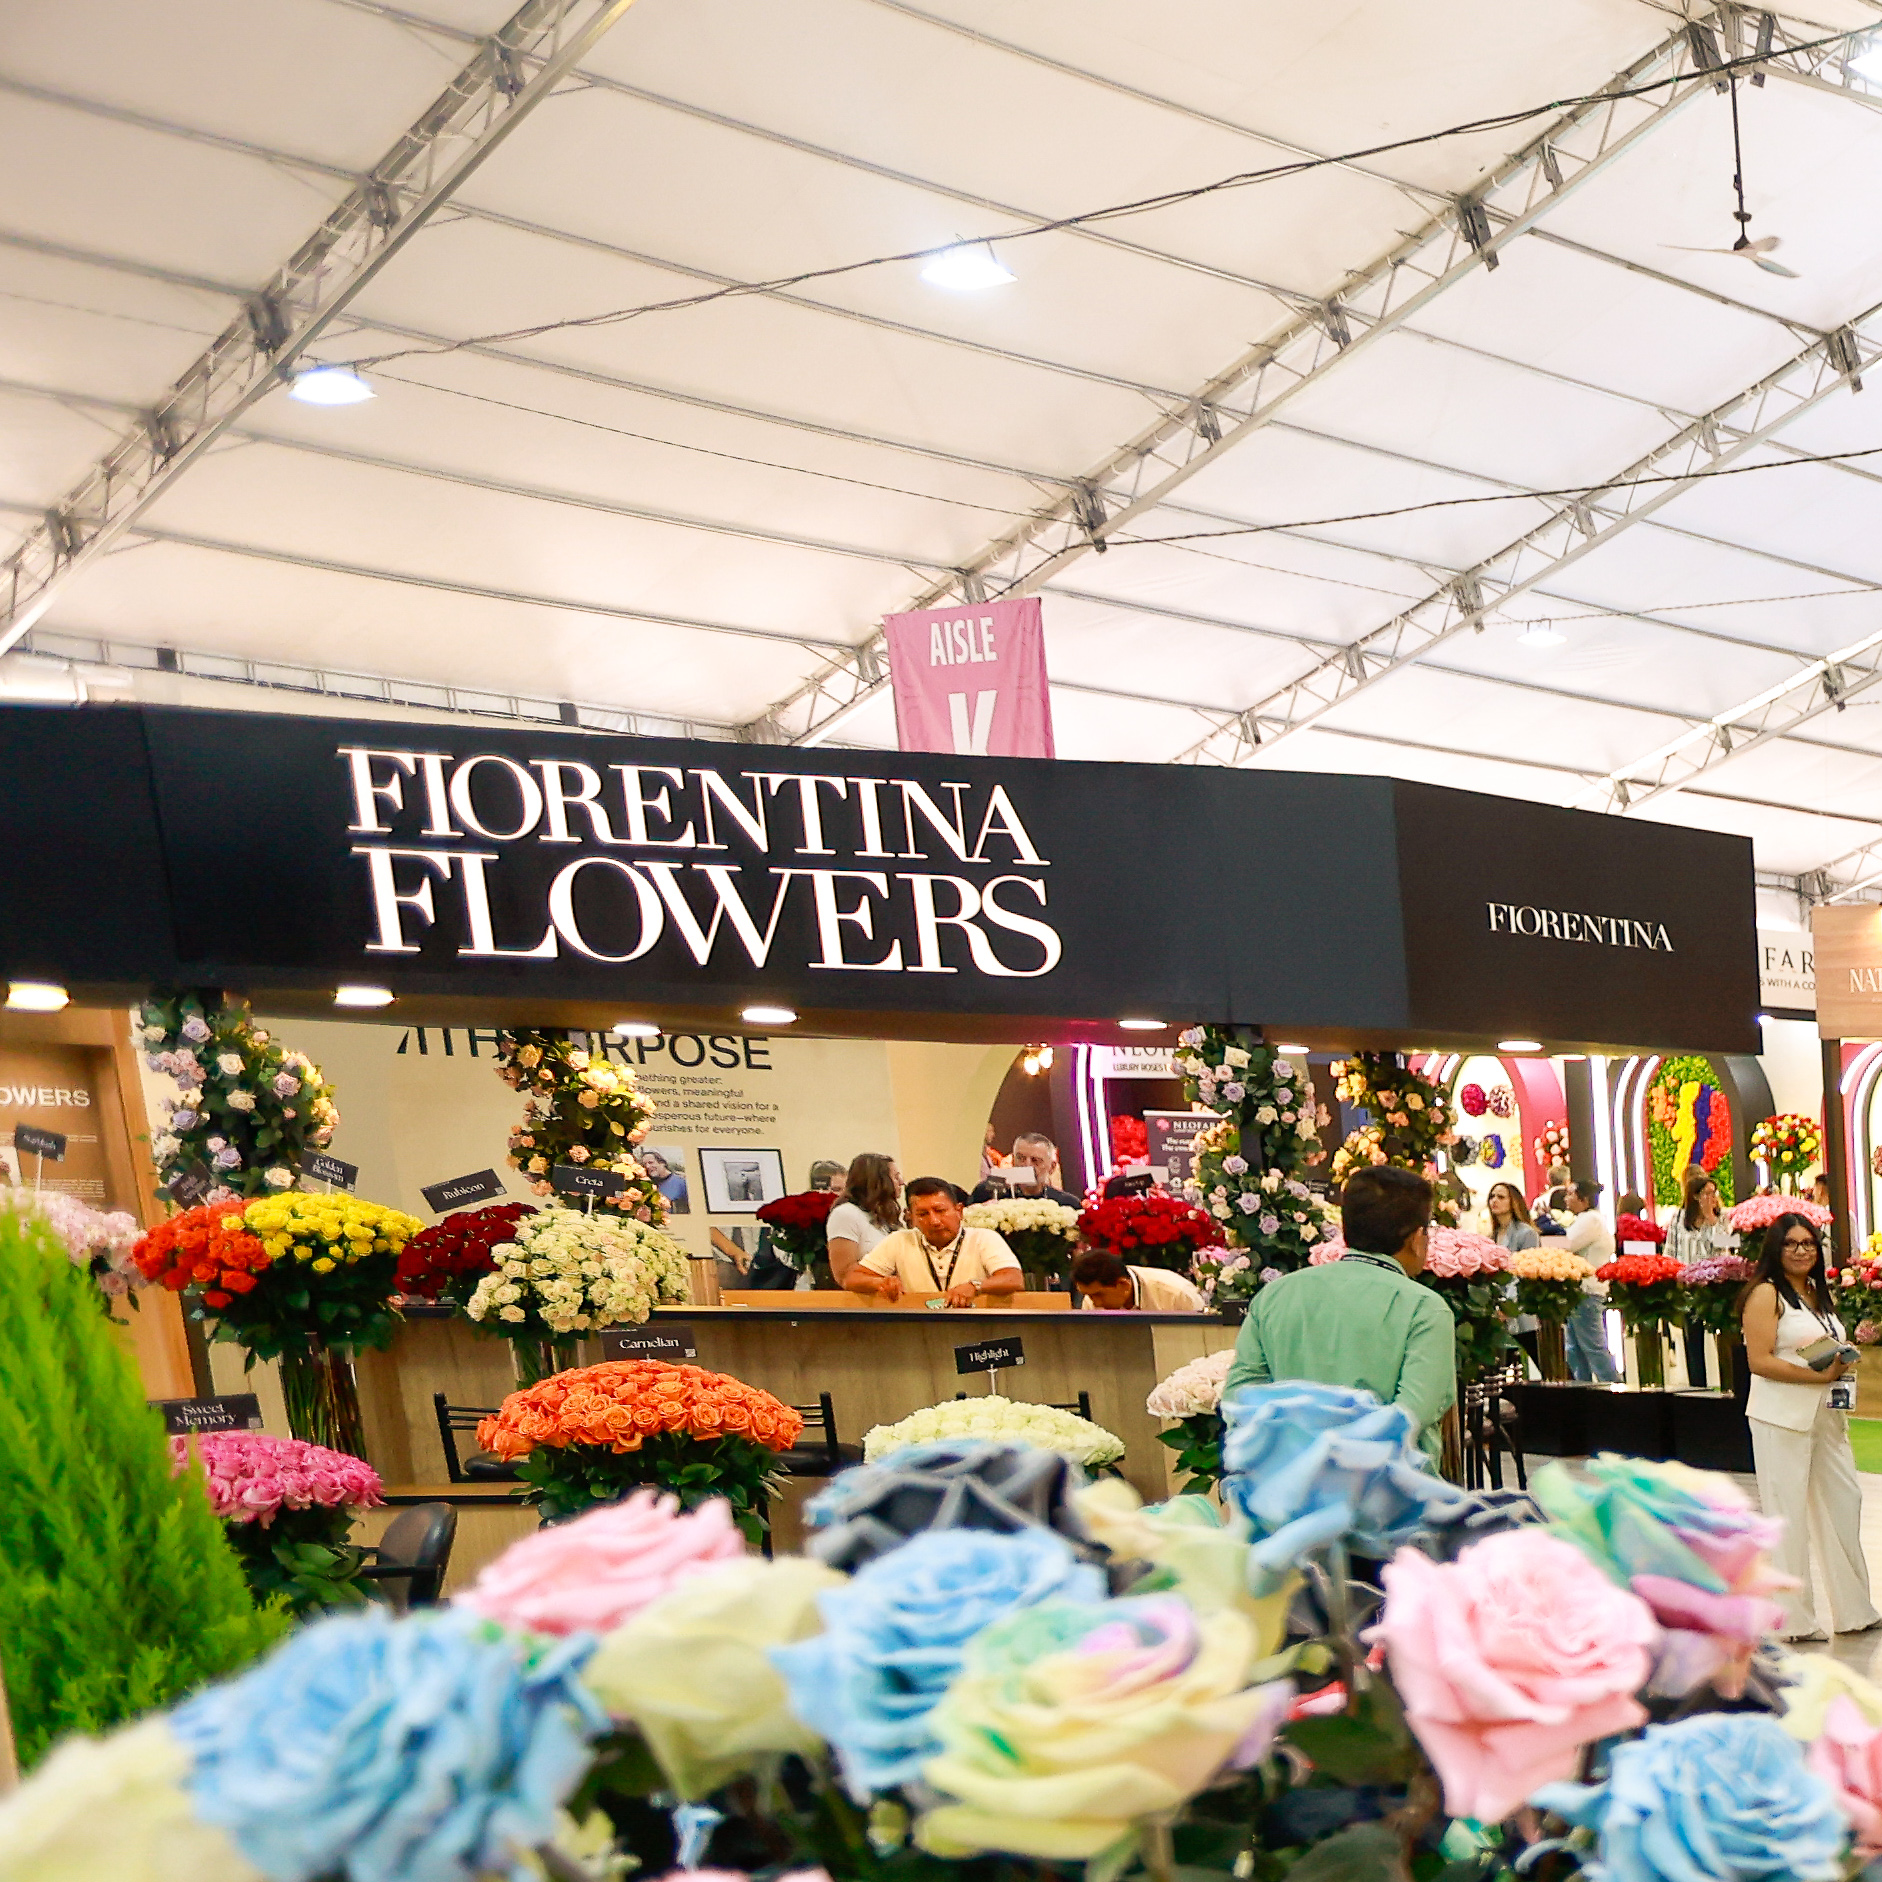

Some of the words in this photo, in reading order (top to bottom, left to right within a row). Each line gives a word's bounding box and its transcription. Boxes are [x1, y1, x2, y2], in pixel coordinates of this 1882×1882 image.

[931, 617, 998, 667] AISLE
[337, 745, 1051, 867] FIORENTINA
[351, 846, 1063, 978] FLOWERS
[1486, 902, 1674, 953] FIORENTINA
[442, 1181, 486, 1200] Rubicon
[575, 1175, 604, 1187] Creta
